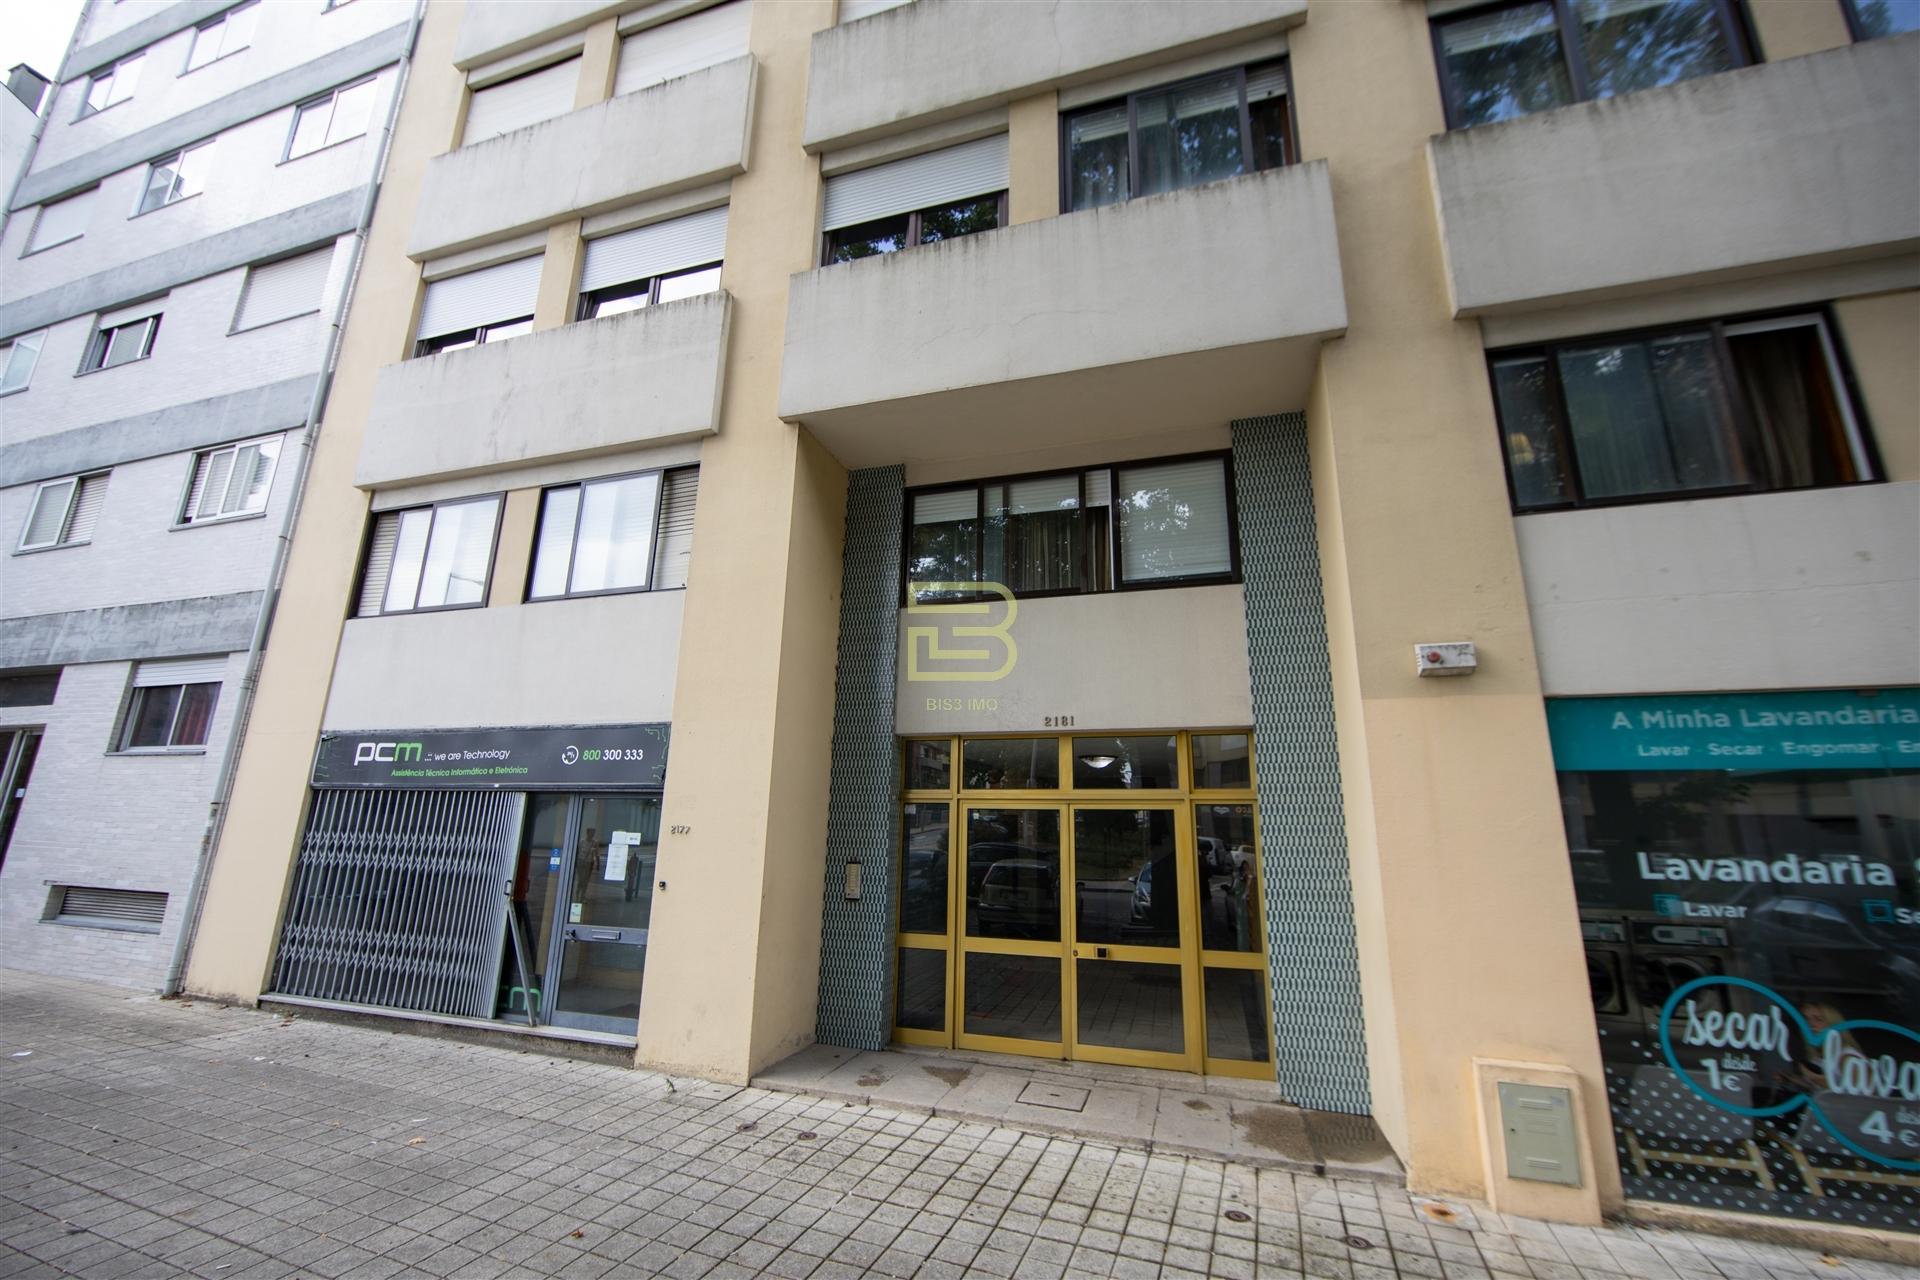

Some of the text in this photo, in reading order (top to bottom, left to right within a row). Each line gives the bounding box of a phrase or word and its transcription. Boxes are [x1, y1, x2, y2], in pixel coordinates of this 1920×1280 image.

[1044, 715, 1075, 728] 2181
[1611, 703, 1920, 730] A Minha Lavandaria
[354, 742, 423, 766] pcm
[434, 748, 511, 761] we are Technology
[582, 749, 601, 761] 800
[603, 748, 622, 761] 300
[624, 748, 644, 761] 333
[1637, 744, 1691, 757] Lavar
[1707, 742, 1764, 756] Secar
[1781, 741, 1881, 757] Engomar
[1636, 852, 1896, 887] Lavandaria
[1682, 900, 1748, 918] Lavar
[1682, 999, 1792, 1062] secar
